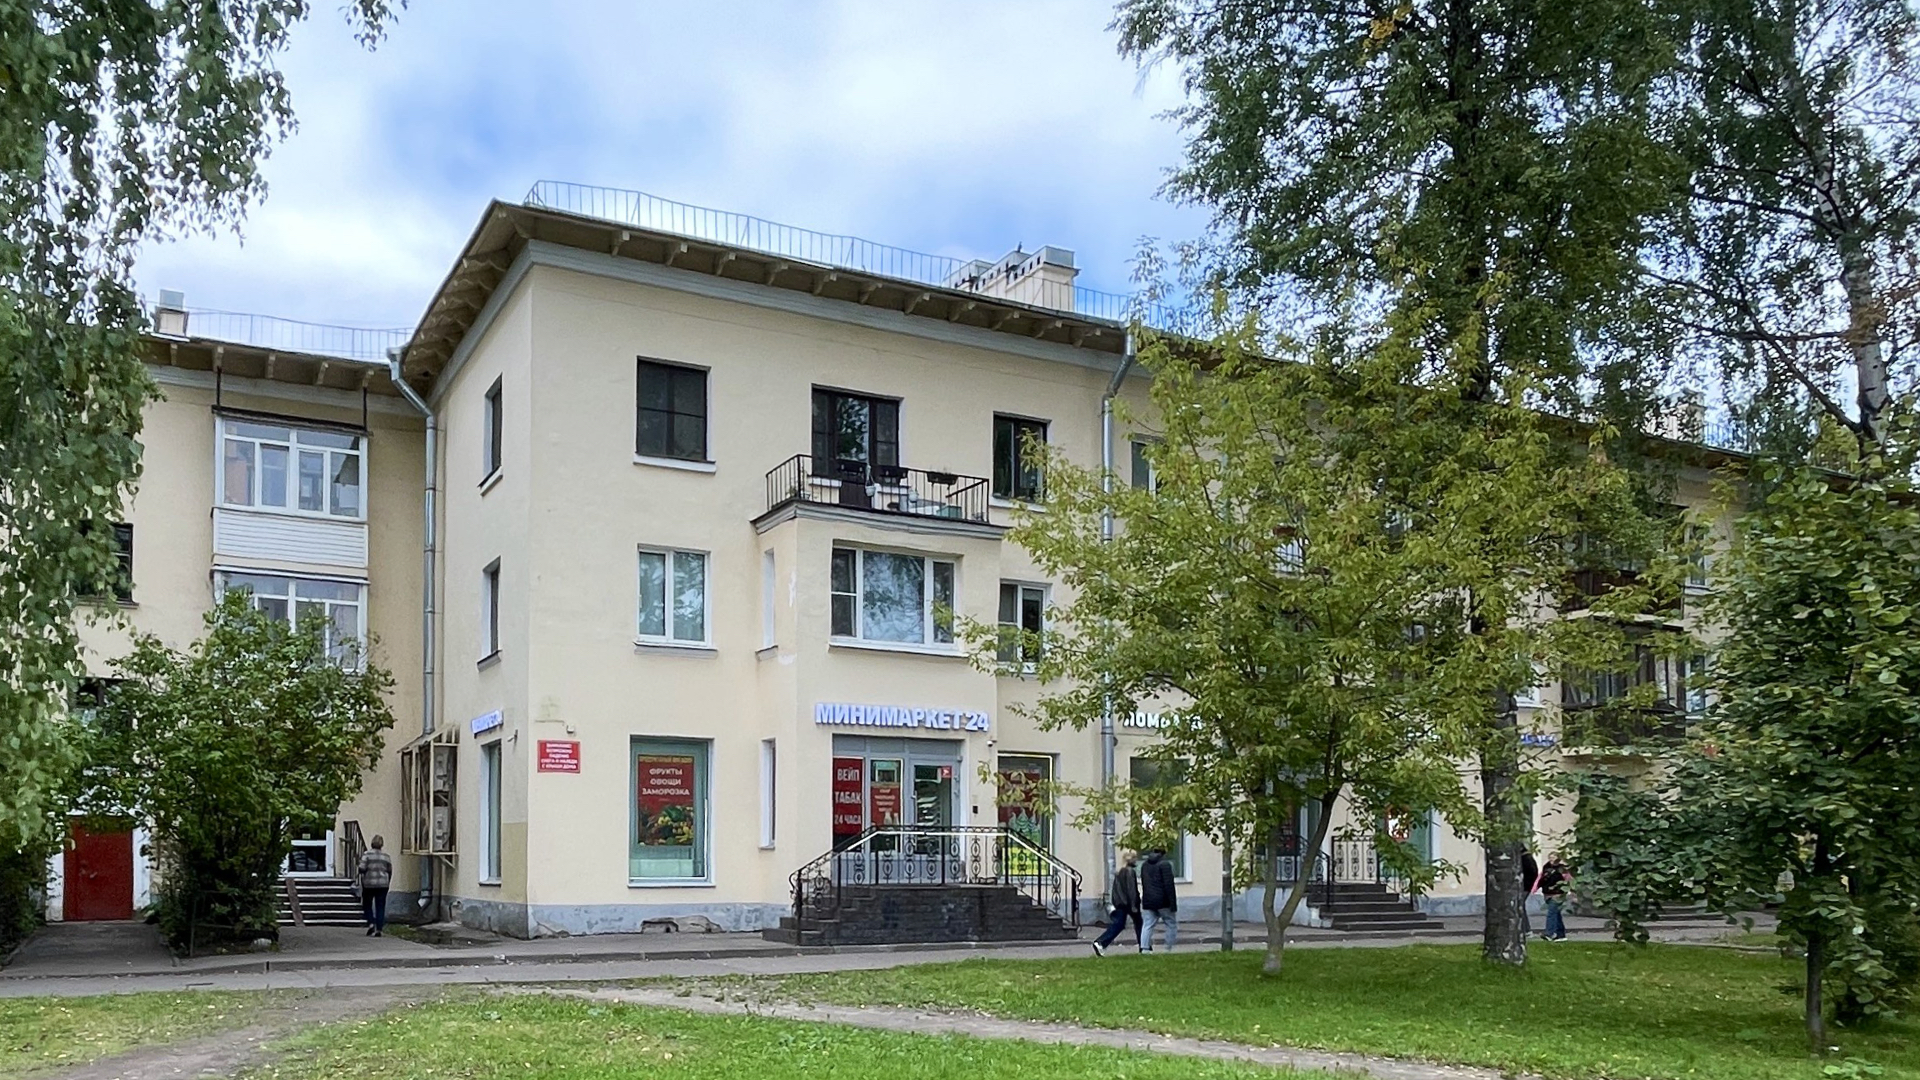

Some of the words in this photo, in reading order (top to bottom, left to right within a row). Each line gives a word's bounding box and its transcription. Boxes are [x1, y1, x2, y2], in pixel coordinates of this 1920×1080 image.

[837, 766, 860, 781] ВЕЙП
[650, 778, 682, 786] ОВОЩИ
[642, 787, 690, 796] ЗАМОРОЗКА
[834, 791, 862, 804] ТАБАК
[834, 814, 844, 825] 24
[844, 814, 862, 825] ЧАСА
